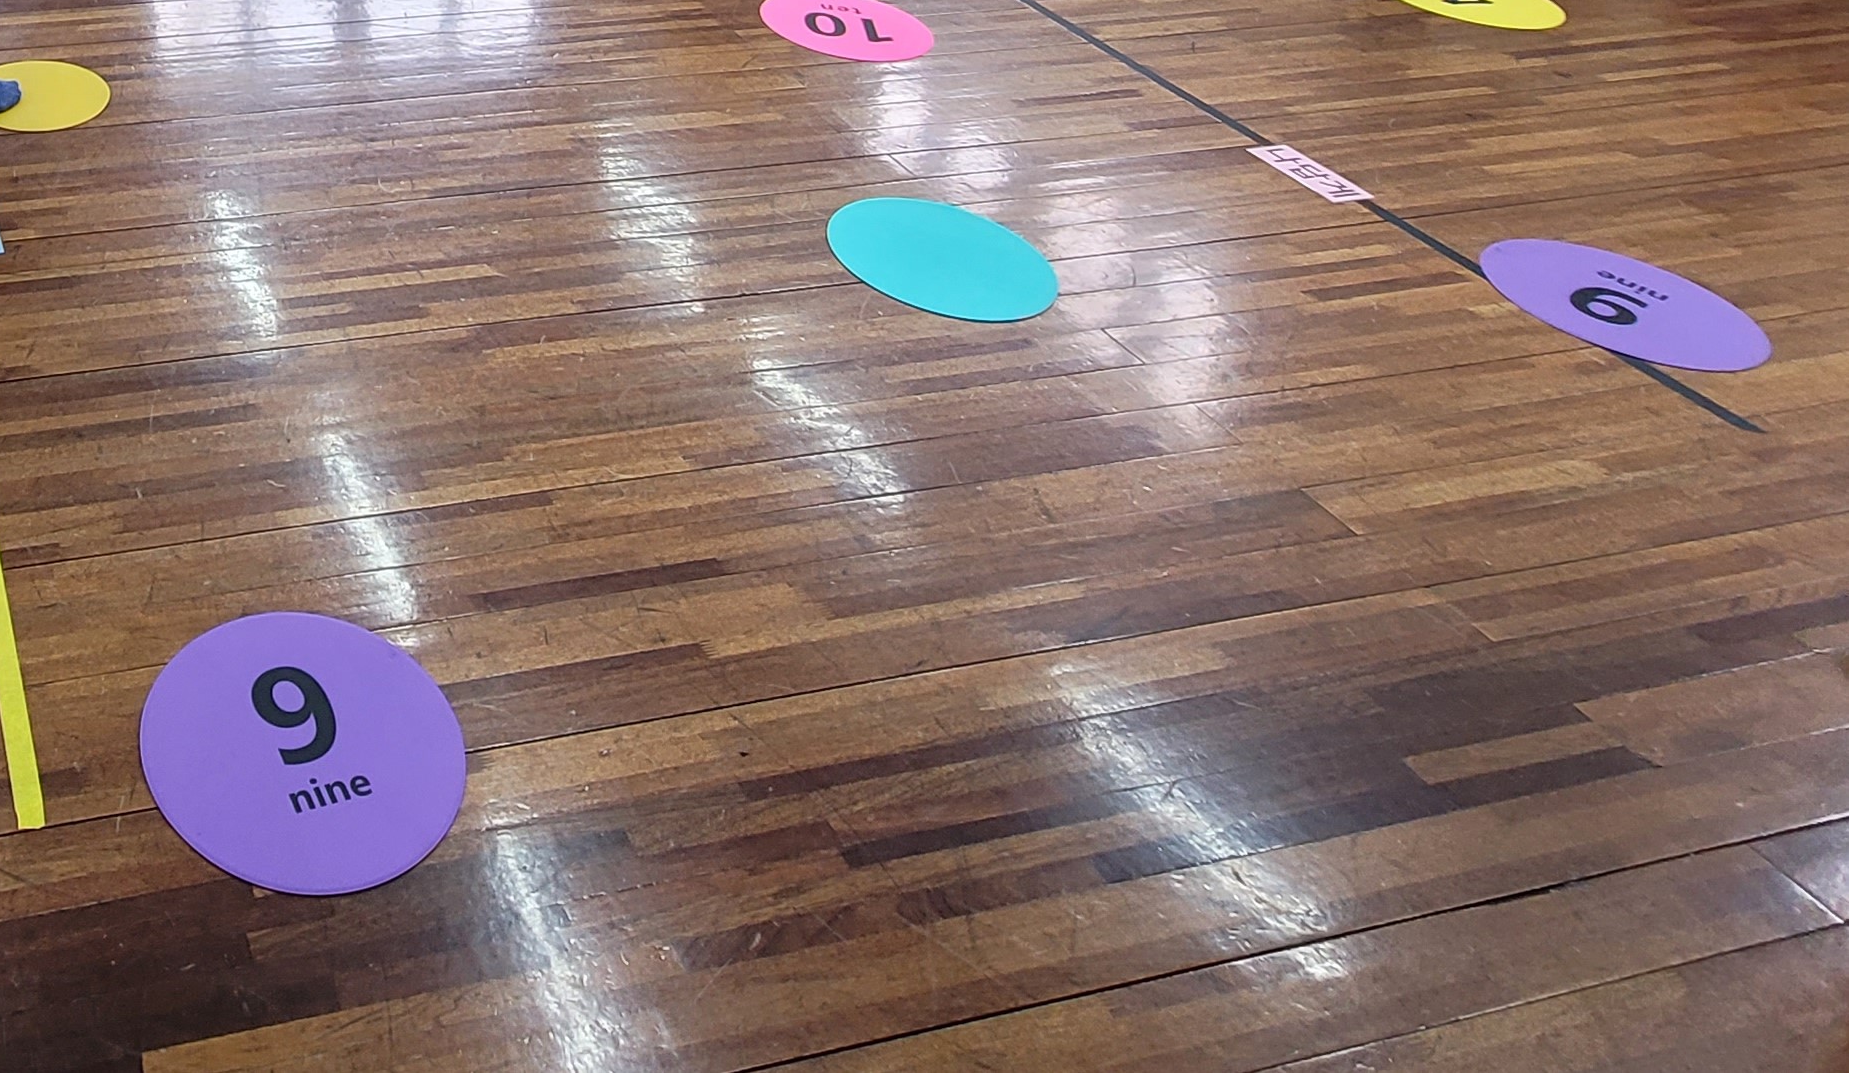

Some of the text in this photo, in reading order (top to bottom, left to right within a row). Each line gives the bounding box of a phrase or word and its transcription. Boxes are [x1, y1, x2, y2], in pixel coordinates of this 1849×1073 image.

[820, 3, 861, 15] ten
[804, 12, 893, 42] 10
[1266, 148, 1361, 198] 나답게
[1596, 270, 1669, 301] nine
[251, 666, 337, 765] 9
[288, 775, 373, 814] nine
